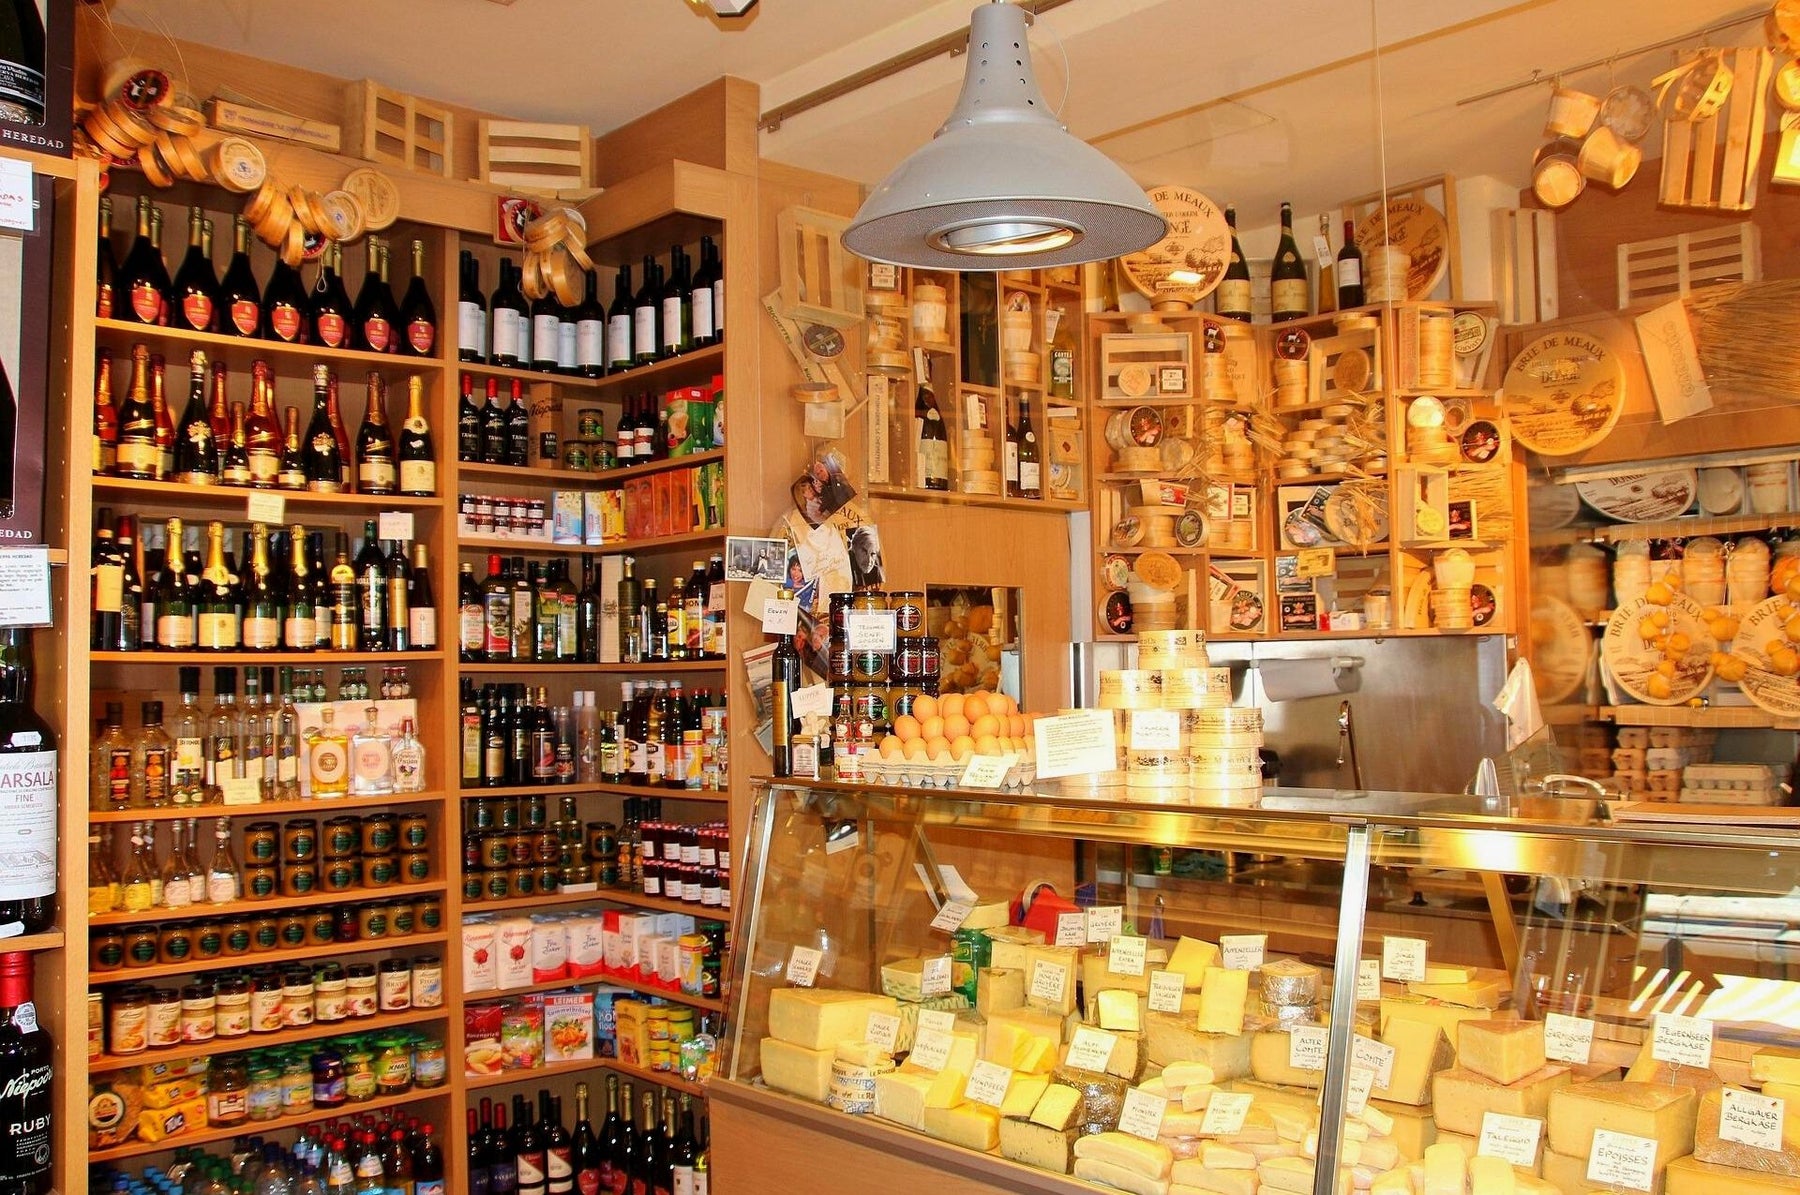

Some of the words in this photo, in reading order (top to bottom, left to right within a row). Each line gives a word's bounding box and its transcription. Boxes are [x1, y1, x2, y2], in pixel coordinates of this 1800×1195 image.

[3, 129, 64, 149] HEREDAD
[1154, 191, 1168, 203] DE
[1174, 192, 1213, 218] MEAUX
[1544, 339, 1559, 349] DE
[1564, 337, 1606, 361] MEAUX
[0, 529, 33, 539] EDAD
[1611, 608, 1633, 637] BRIE
[1673, 597, 1703, 621] EAUX
[0, 771, 54, 788] ARSALA
[15, 793, 34, 802] FINE
[553, 997, 585, 1006] LEIMER
[9, 1113, 51, 1136] RUBY
